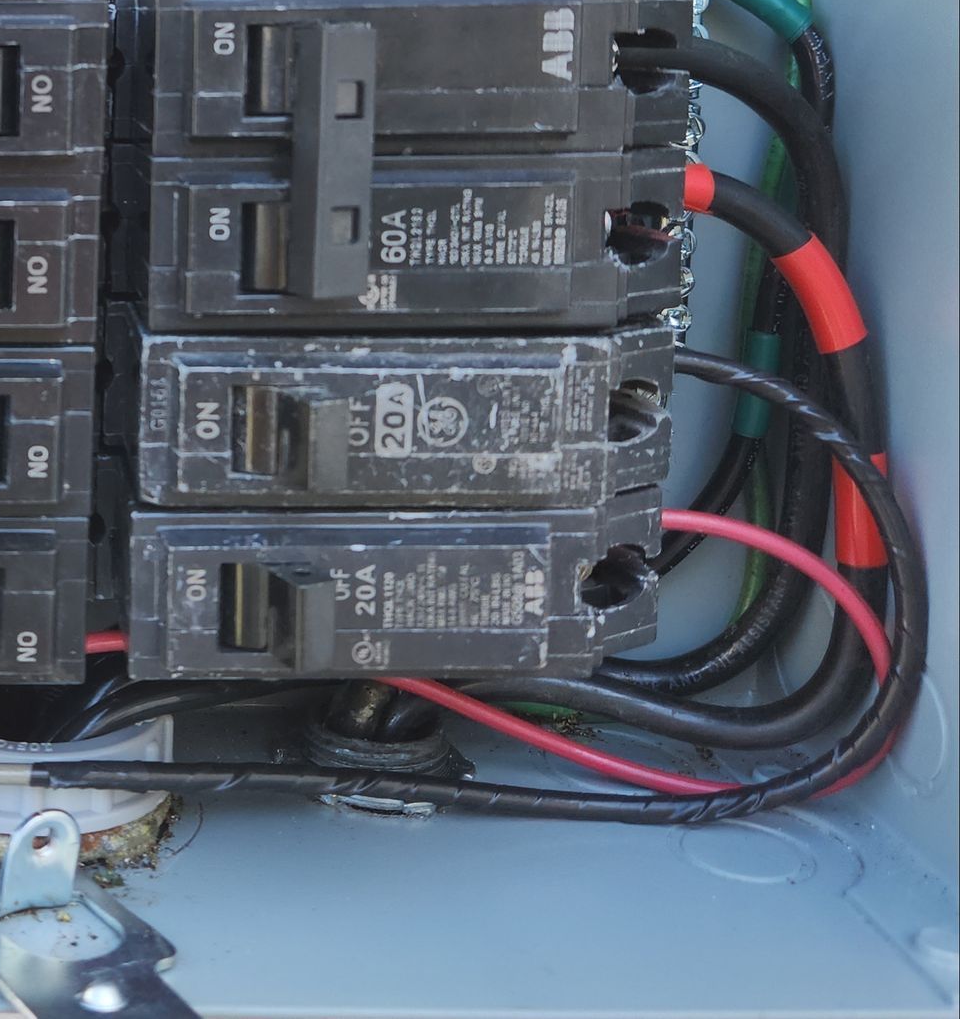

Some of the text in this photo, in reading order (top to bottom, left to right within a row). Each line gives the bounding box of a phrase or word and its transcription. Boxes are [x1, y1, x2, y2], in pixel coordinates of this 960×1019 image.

[213, 21, 236, 56] ON
[540, 6, 575, 81] ABB
[30, 74, 53, 114] ON
[208, 206, 230, 241] ON
[380, 209, 407, 264] 60A
[26, 256, 49, 295] ON
[195, 400, 220, 440] ON
[349, 396, 371, 447] OFF
[381, 390, 406, 449] 20A
[26, 444, 49, 479] ON
[185, 568, 207, 602] ON
[355, 564, 377, 616] 20A
[524, 567, 546, 616] ABB
[16, 630, 38, 663] ON
